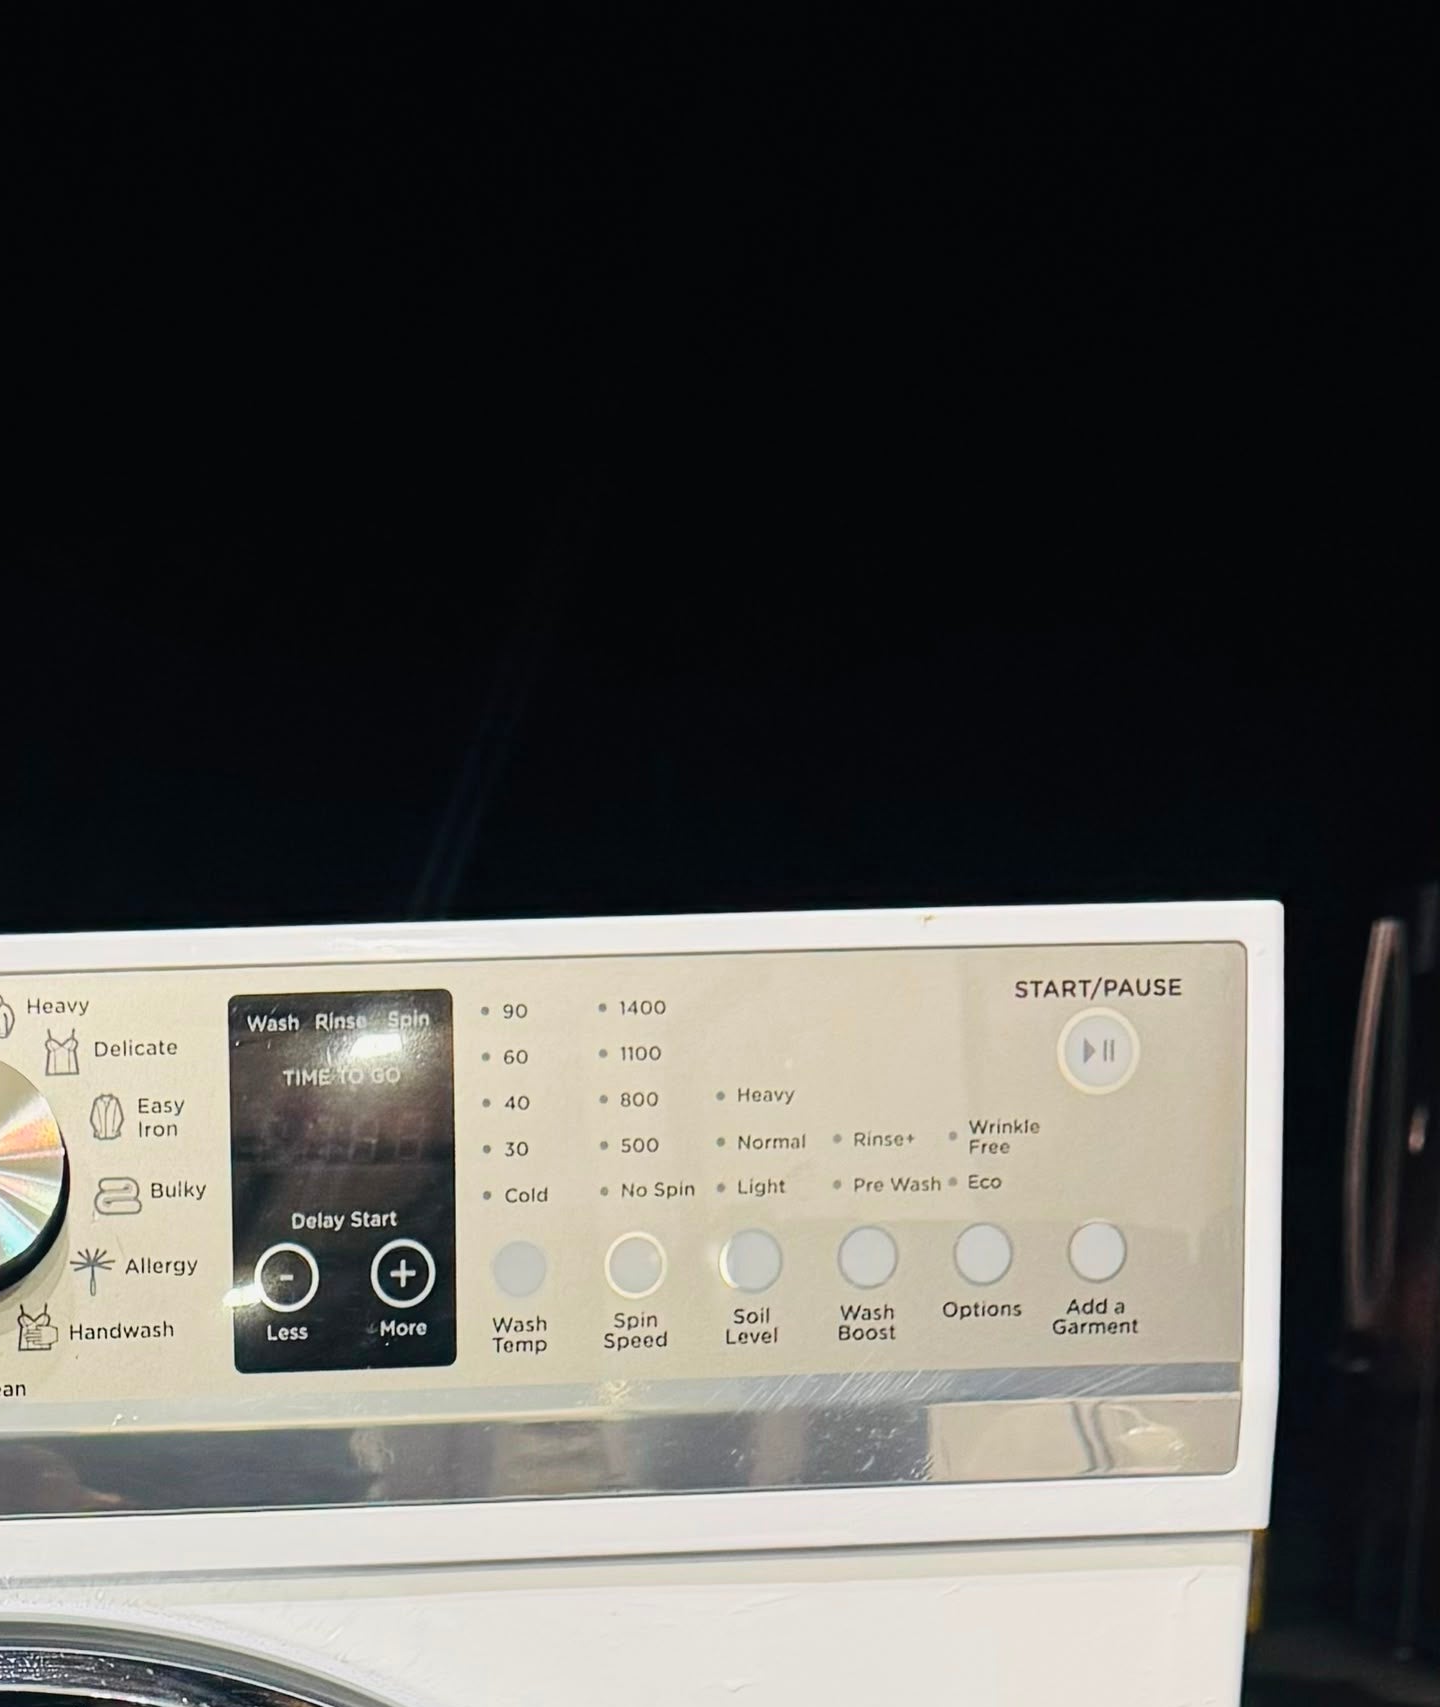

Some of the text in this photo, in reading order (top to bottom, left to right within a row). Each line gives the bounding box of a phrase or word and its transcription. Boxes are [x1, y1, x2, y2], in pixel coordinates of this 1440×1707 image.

[1015, 977, 1182, 999] START/PAUSE
[27, 997, 89, 1016] Heavy
[503, 1004, 528, 1019] 90
[620, 1000, 666, 1015] 1400
[247, 1009, 430, 1032] Wash Rinse Spin
[94, 1039, 177, 1057] Delicate
[620, 1046, 661, 1061] 1100
[503, 1050, 528, 1065] 60
[283, 1067, 401, 1087] TIME TO GO
[505, 1096, 530, 1110] 40
[620, 1092, 658, 1107] 800
[738, 1088, 795, 1105] Heavy
[138, 1097, 184, 1117] Easy
[138, 1120, 178, 1137] Iron
[969, 1119, 1040, 1134] Wrinkle
[621, 1138, 659, 1153] 500
[738, 1134, 806, 1150] Normal
[854, 1131, 915, 1147] Rinse+
[969, 1140, 1010, 1154] Free
[505, 1142, 528, 1157] 30
[151, 1180, 206, 1201] Bulky
[621, 1180, 695, 1200] No Spin
[738, 1179, 786, 1197] Light
[854, 1177, 941, 1193] Pre Wash
[968, 1175, 1002, 1190] Eco
[505, 1187, 548, 1203] Cold
[292, 1210, 397, 1232] Delay Start
[125, 1256, 198, 1278] Allergy
[841, 1304, 894, 1321] Wash
[943, 1302, 1022, 1319] Options
[1067, 1299, 1125, 1314] Add a
[614, 1311, 658, 1331] Spin
[733, 1307, 770, 1324] Soil
[69, 1322, 173, 1340] Handwash
[267, 1323, 308, 1342] Less
[380, 1319, 427, 1337] More
[492, 1316, 547, 1333] Wash
[839, 1325, 896, 1340] Boost
[1052, 1319, 1138, 1335] Garment
[603, 1330, 668, 1351] Speed
[725, 1325, 778, 1345] Level
[492, 1335, 548, 1354] Temp
